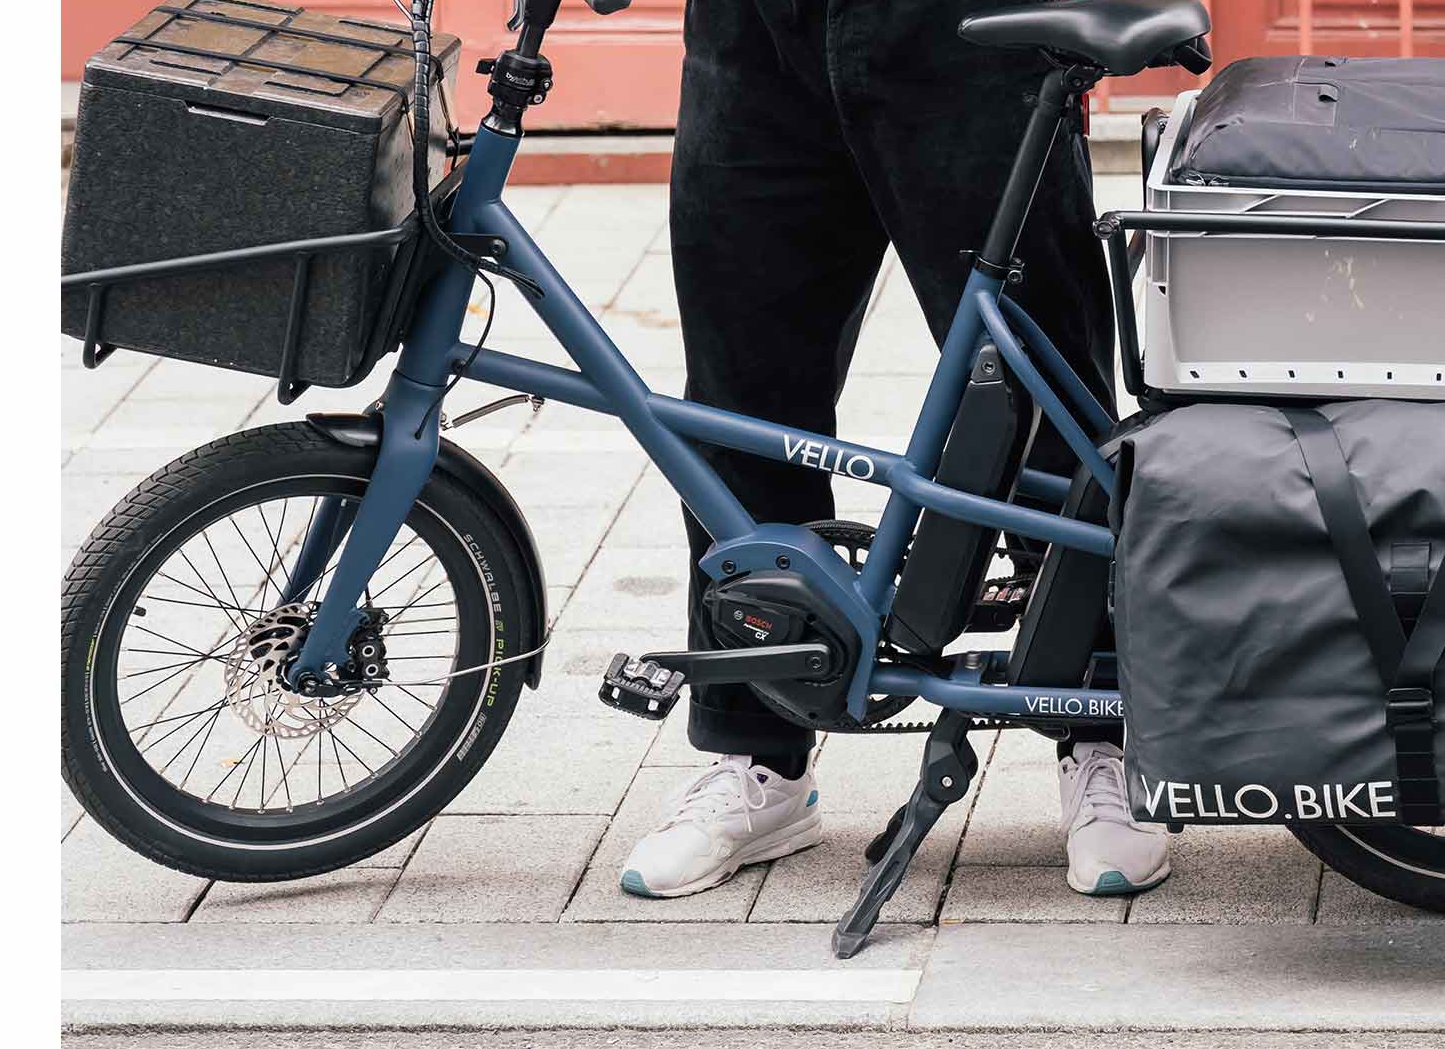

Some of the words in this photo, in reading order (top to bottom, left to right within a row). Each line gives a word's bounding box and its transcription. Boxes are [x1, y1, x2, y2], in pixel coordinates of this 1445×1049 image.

[783, 434, 875, 480] VELLO
[463, 534, 502, 613] SCHWALBE
[1025, 696, 1125, 717] VELLO.BIKE
[1140, 774, 1397, 820] VELLO.BIKE
